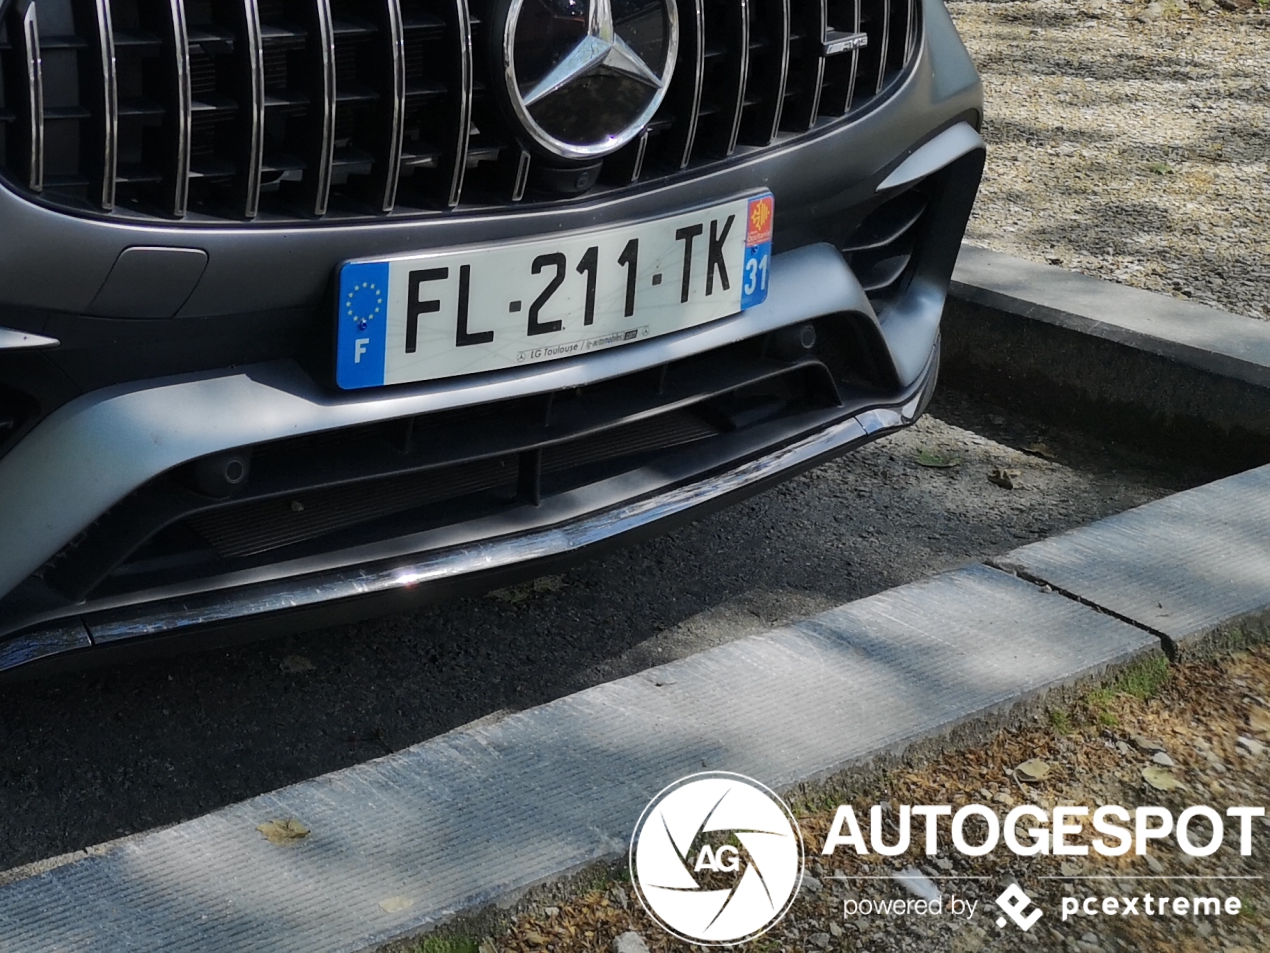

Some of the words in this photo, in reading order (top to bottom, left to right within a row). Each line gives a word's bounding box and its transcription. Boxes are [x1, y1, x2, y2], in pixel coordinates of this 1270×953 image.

[404, 214, 736, 354] FL-211-TK
[744, 255, 767, 295] 31
[353, 337, 370, 364] F
[530, 349, 542, 360] LG
[543, 342, 579, 357] Toulouse
